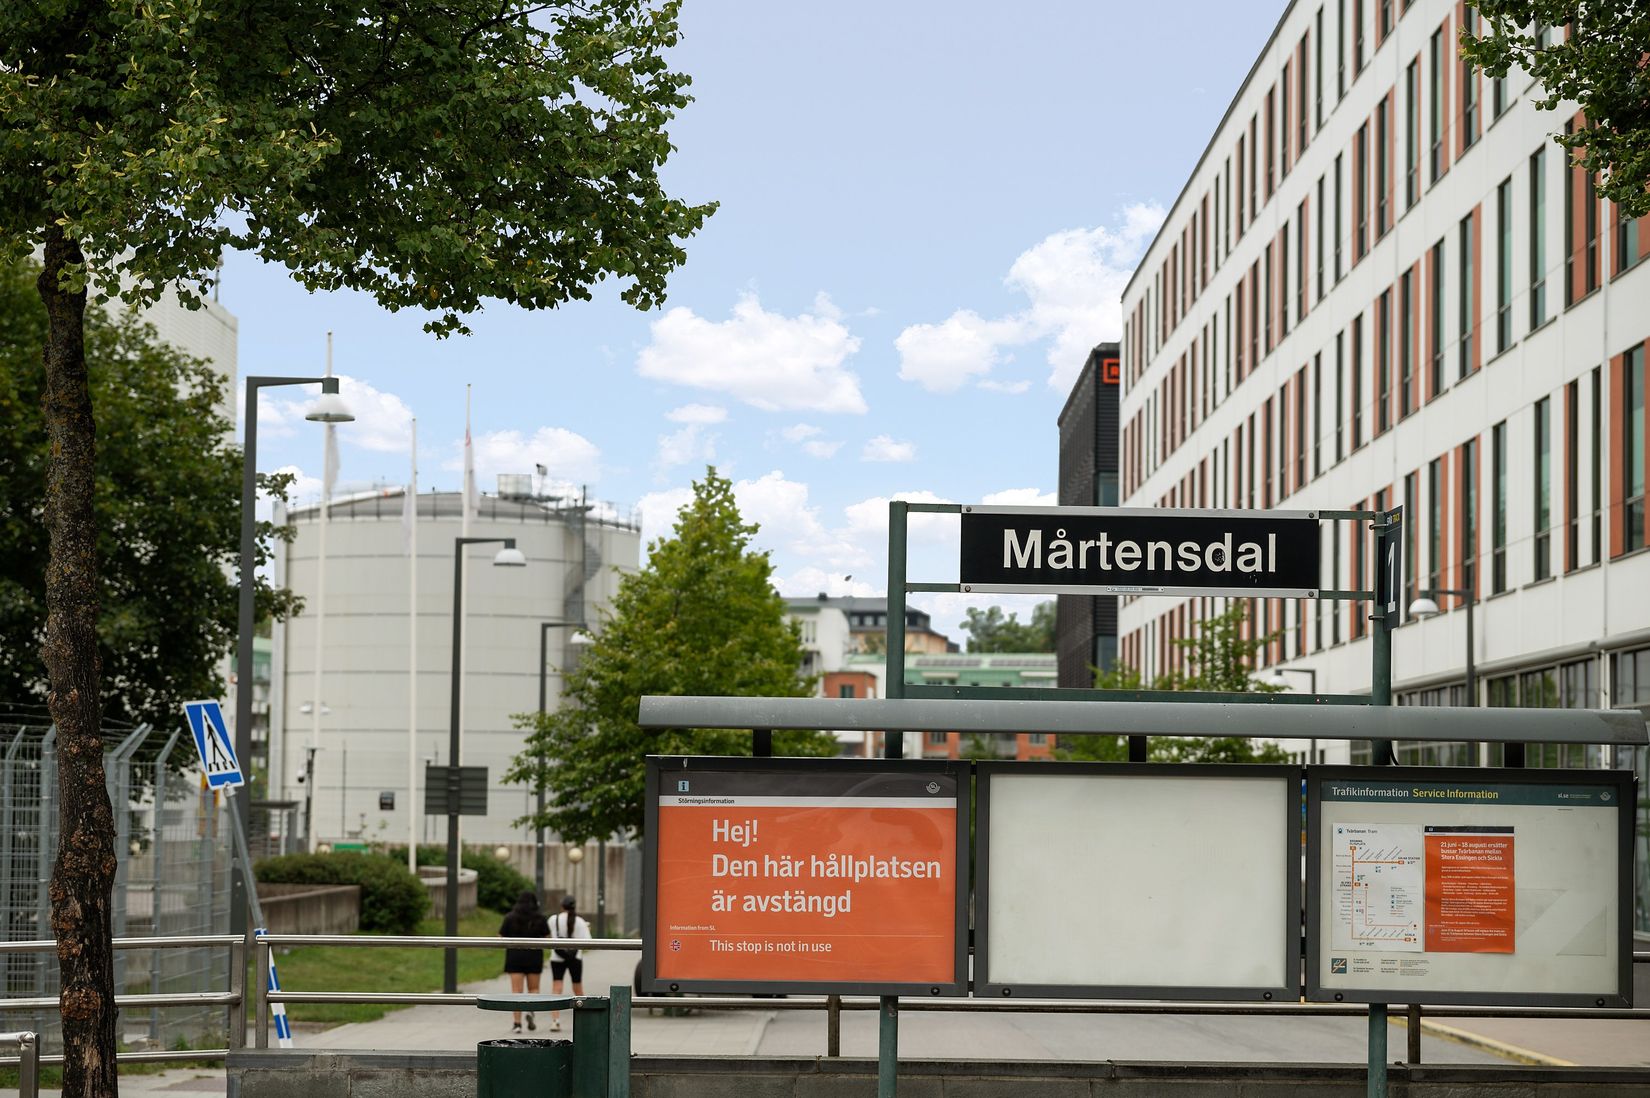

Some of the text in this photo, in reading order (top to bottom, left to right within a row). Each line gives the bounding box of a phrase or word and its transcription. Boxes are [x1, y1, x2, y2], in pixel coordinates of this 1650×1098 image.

[1003, 528, 1277, 573] Mårtensdal
[1388, 542, 1396, 612] 1
[1332, 786, 1498, 799] Trafikinformation Service Information
[712, 819, 758, 847] Hej!
[712, 853, 941, 883] Den här hållplatsen
[711, 890, 851, 918] är avstängd
[710, 940, 832, 954] This stop is not in use
